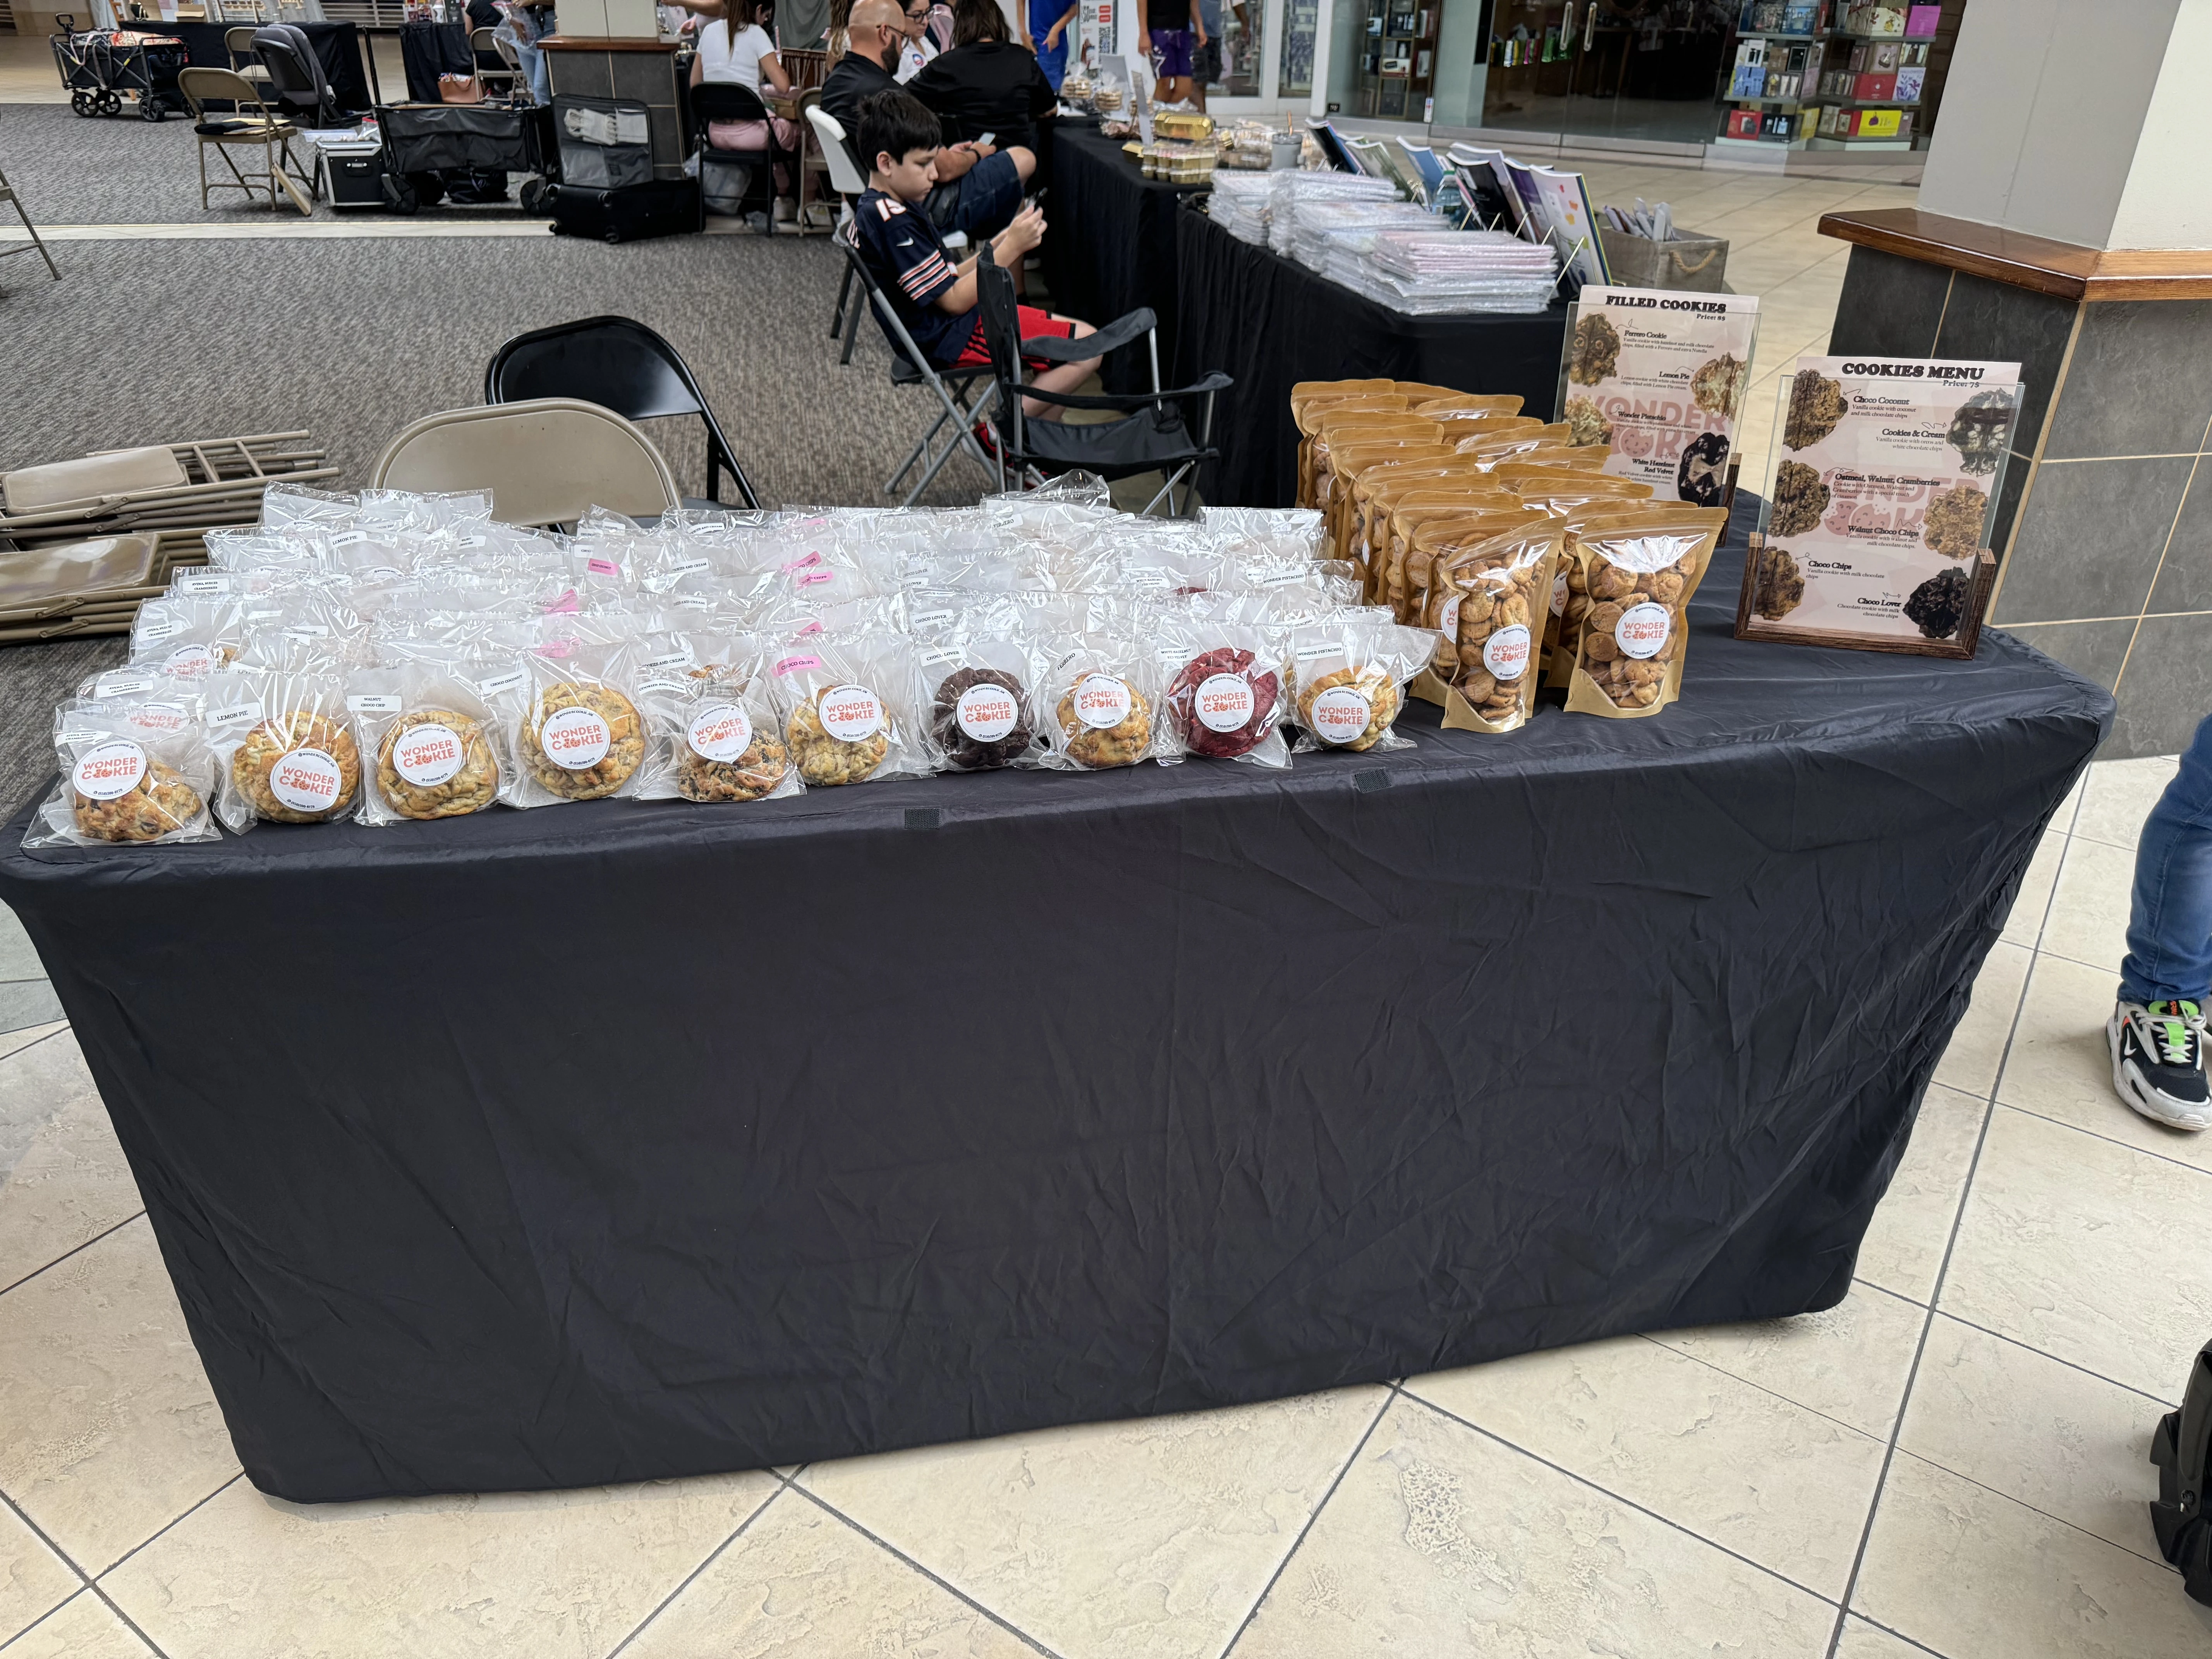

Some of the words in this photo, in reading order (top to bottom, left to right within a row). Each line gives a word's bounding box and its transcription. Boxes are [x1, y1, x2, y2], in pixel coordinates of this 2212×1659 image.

[1606, 295, 1657, 307] FILLED
[1660, 300, 1726, 314] COOKIES
[1842, 363, 1924, 377] COOKIES
[1927, 366, 1985, 380] MENU
[1835, 474, 1866, 482] Oatmeal,
[1868, 476, 1895, 484] Walnut,
[1848, 525, 1873, 533] Walnut
[1898, 529, 1919, 537] Chips
[332, 536, 349, 545] LEMON
[1832, 562, 1851, 570] Chips
[1492, 642, 1527, 653] WONDER
[781, 661, 798, 670] CHOCO
[1057, 653, 1075, 670] FERRERO
[505, 674, 522, 683] COCONUT
[1080, 691, 1123, 701] WONDER
[1202, 692, 1247, 702] WONDER
[826, 701, 873, 713] WONDER
[964, 702, 1010, 713] WONDER
[1319, 707, 1363, 715] WONDER
[217, 713, 237, 721] LEMON
[549, 725, 601, 740] WONDER
[695, 718, 742, 737] WONDER
[401, 740, 452, 757] WONDER
[84, 757, 137, 770] WONDER
[283, 766, 335, 785] WONDER
